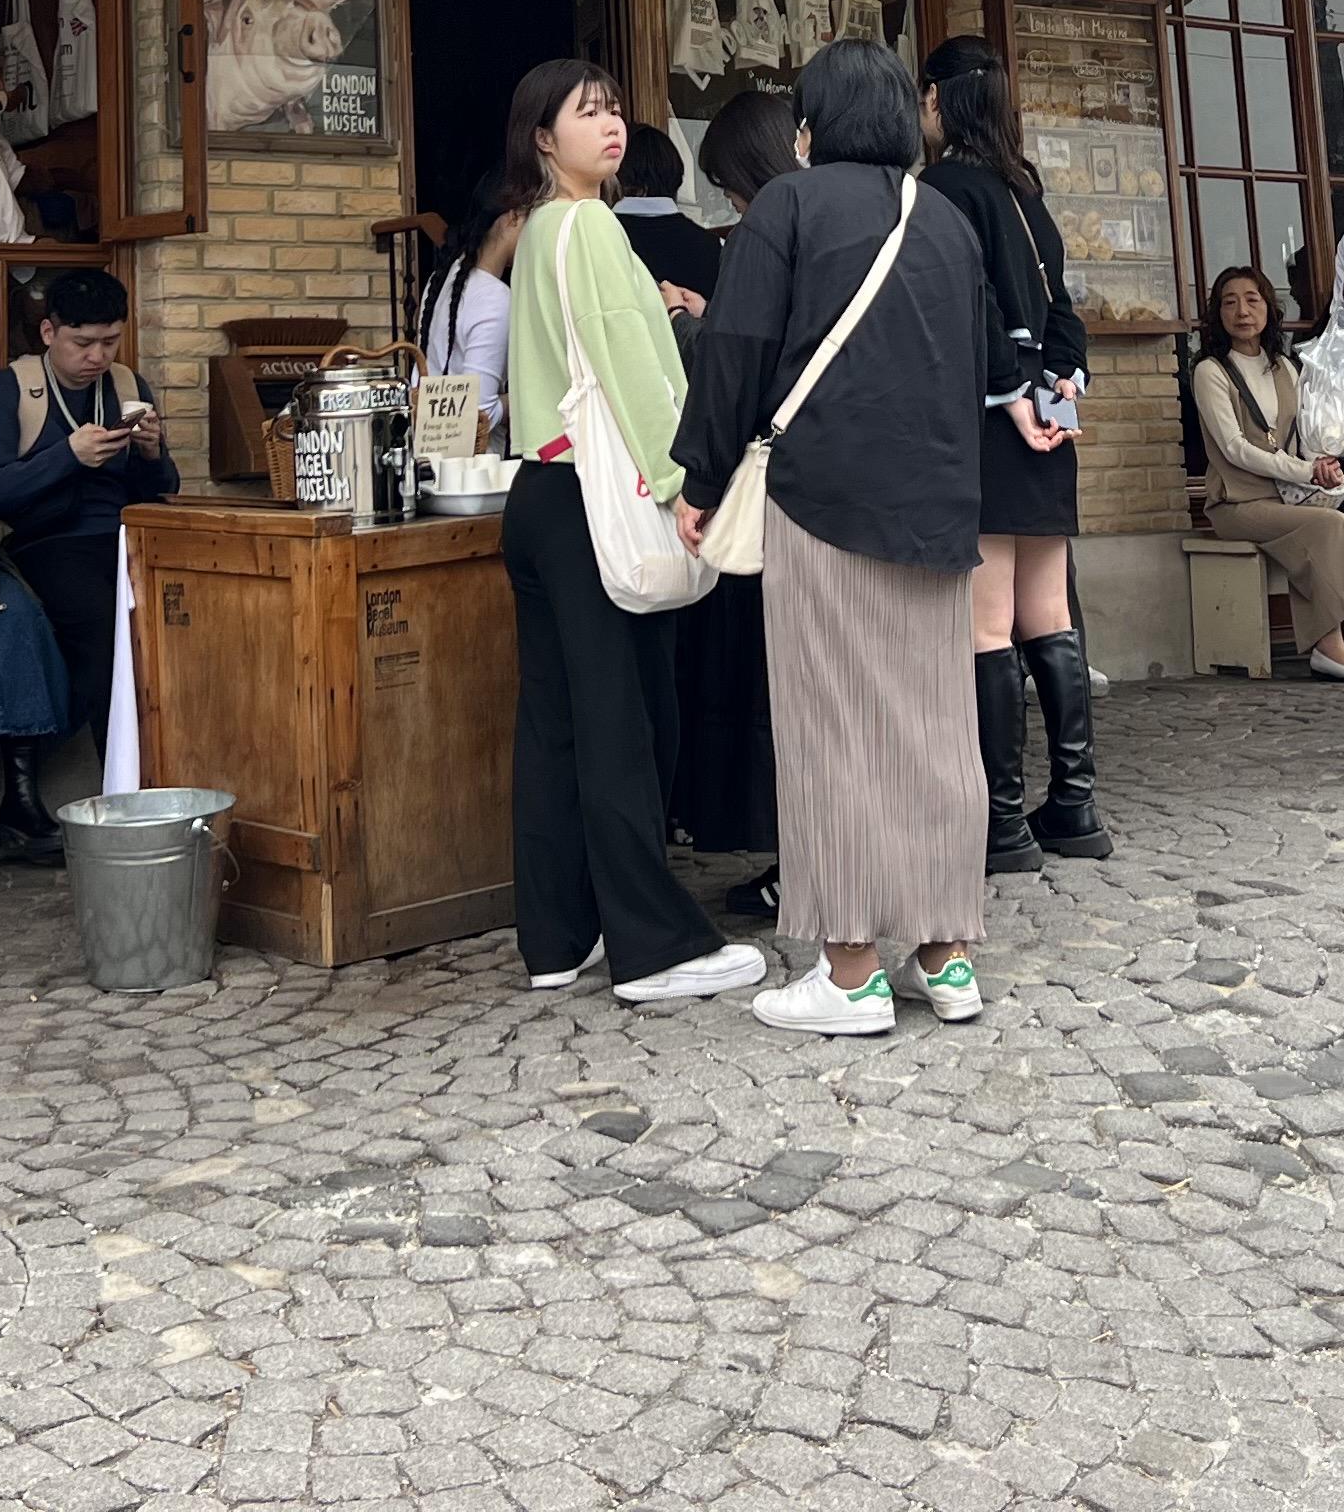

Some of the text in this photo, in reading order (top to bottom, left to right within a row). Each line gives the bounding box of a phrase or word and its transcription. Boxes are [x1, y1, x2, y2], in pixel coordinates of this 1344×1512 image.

[322, 73, 376, 96] LONDON
[322, 95, 366, 115] BAGEL
[323, 114, 376, 134] MUSEUM
[260, 358, 317, 376] action
[320, 389, 352, 410] FREE
[428, 395, 468, 419] TEA!
[365, 589, 402, 607] London
[366, 619, 409, 640] Museum
